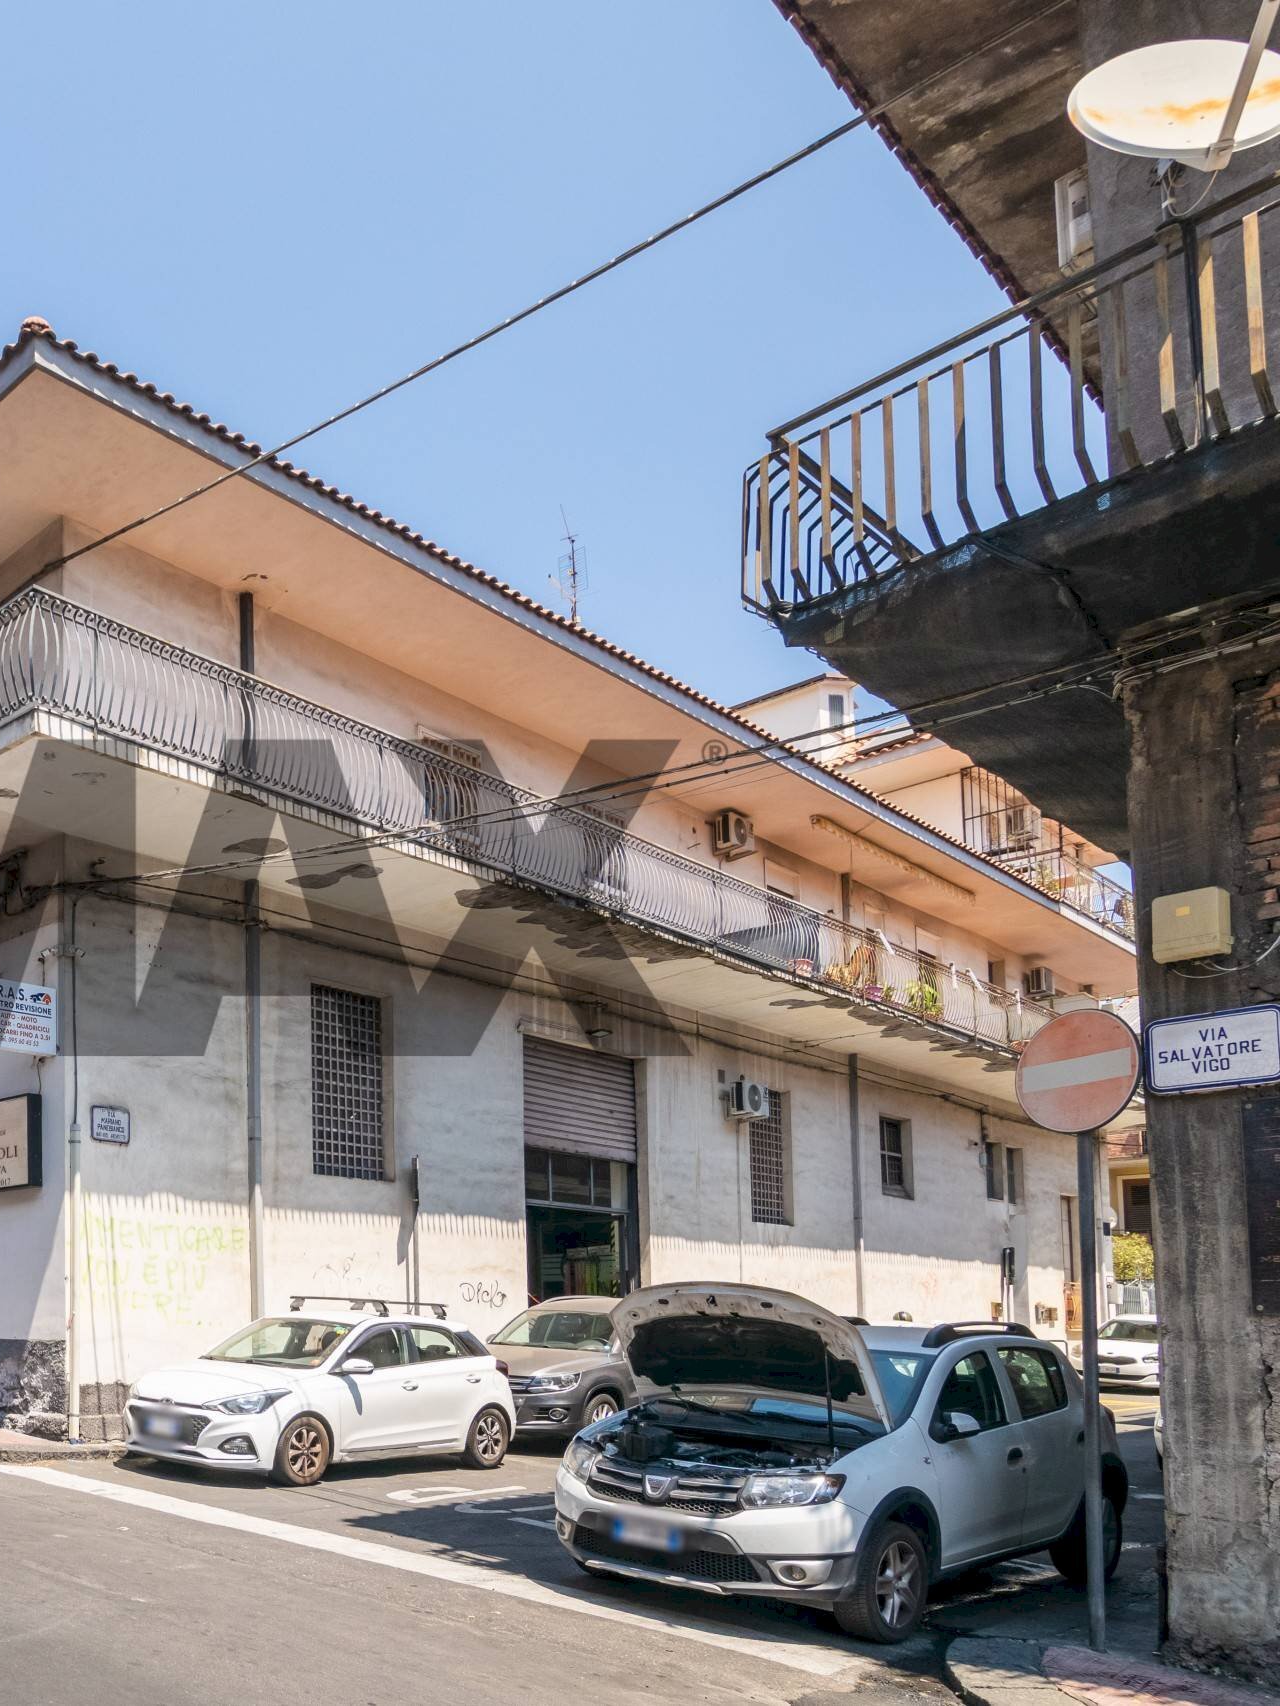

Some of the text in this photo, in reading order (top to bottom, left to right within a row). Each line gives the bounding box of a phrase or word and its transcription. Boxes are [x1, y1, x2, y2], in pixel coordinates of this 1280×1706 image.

[15, 1002, 52, 1015] REVISIONE
[19, 1030, 33, 1038] FINO
[1198, 1026, 1228, 1042] VIA
[1158, 1038, 1262, 1064] SALVATORE
[1191, 1057, 1231, 1074] VIGO
